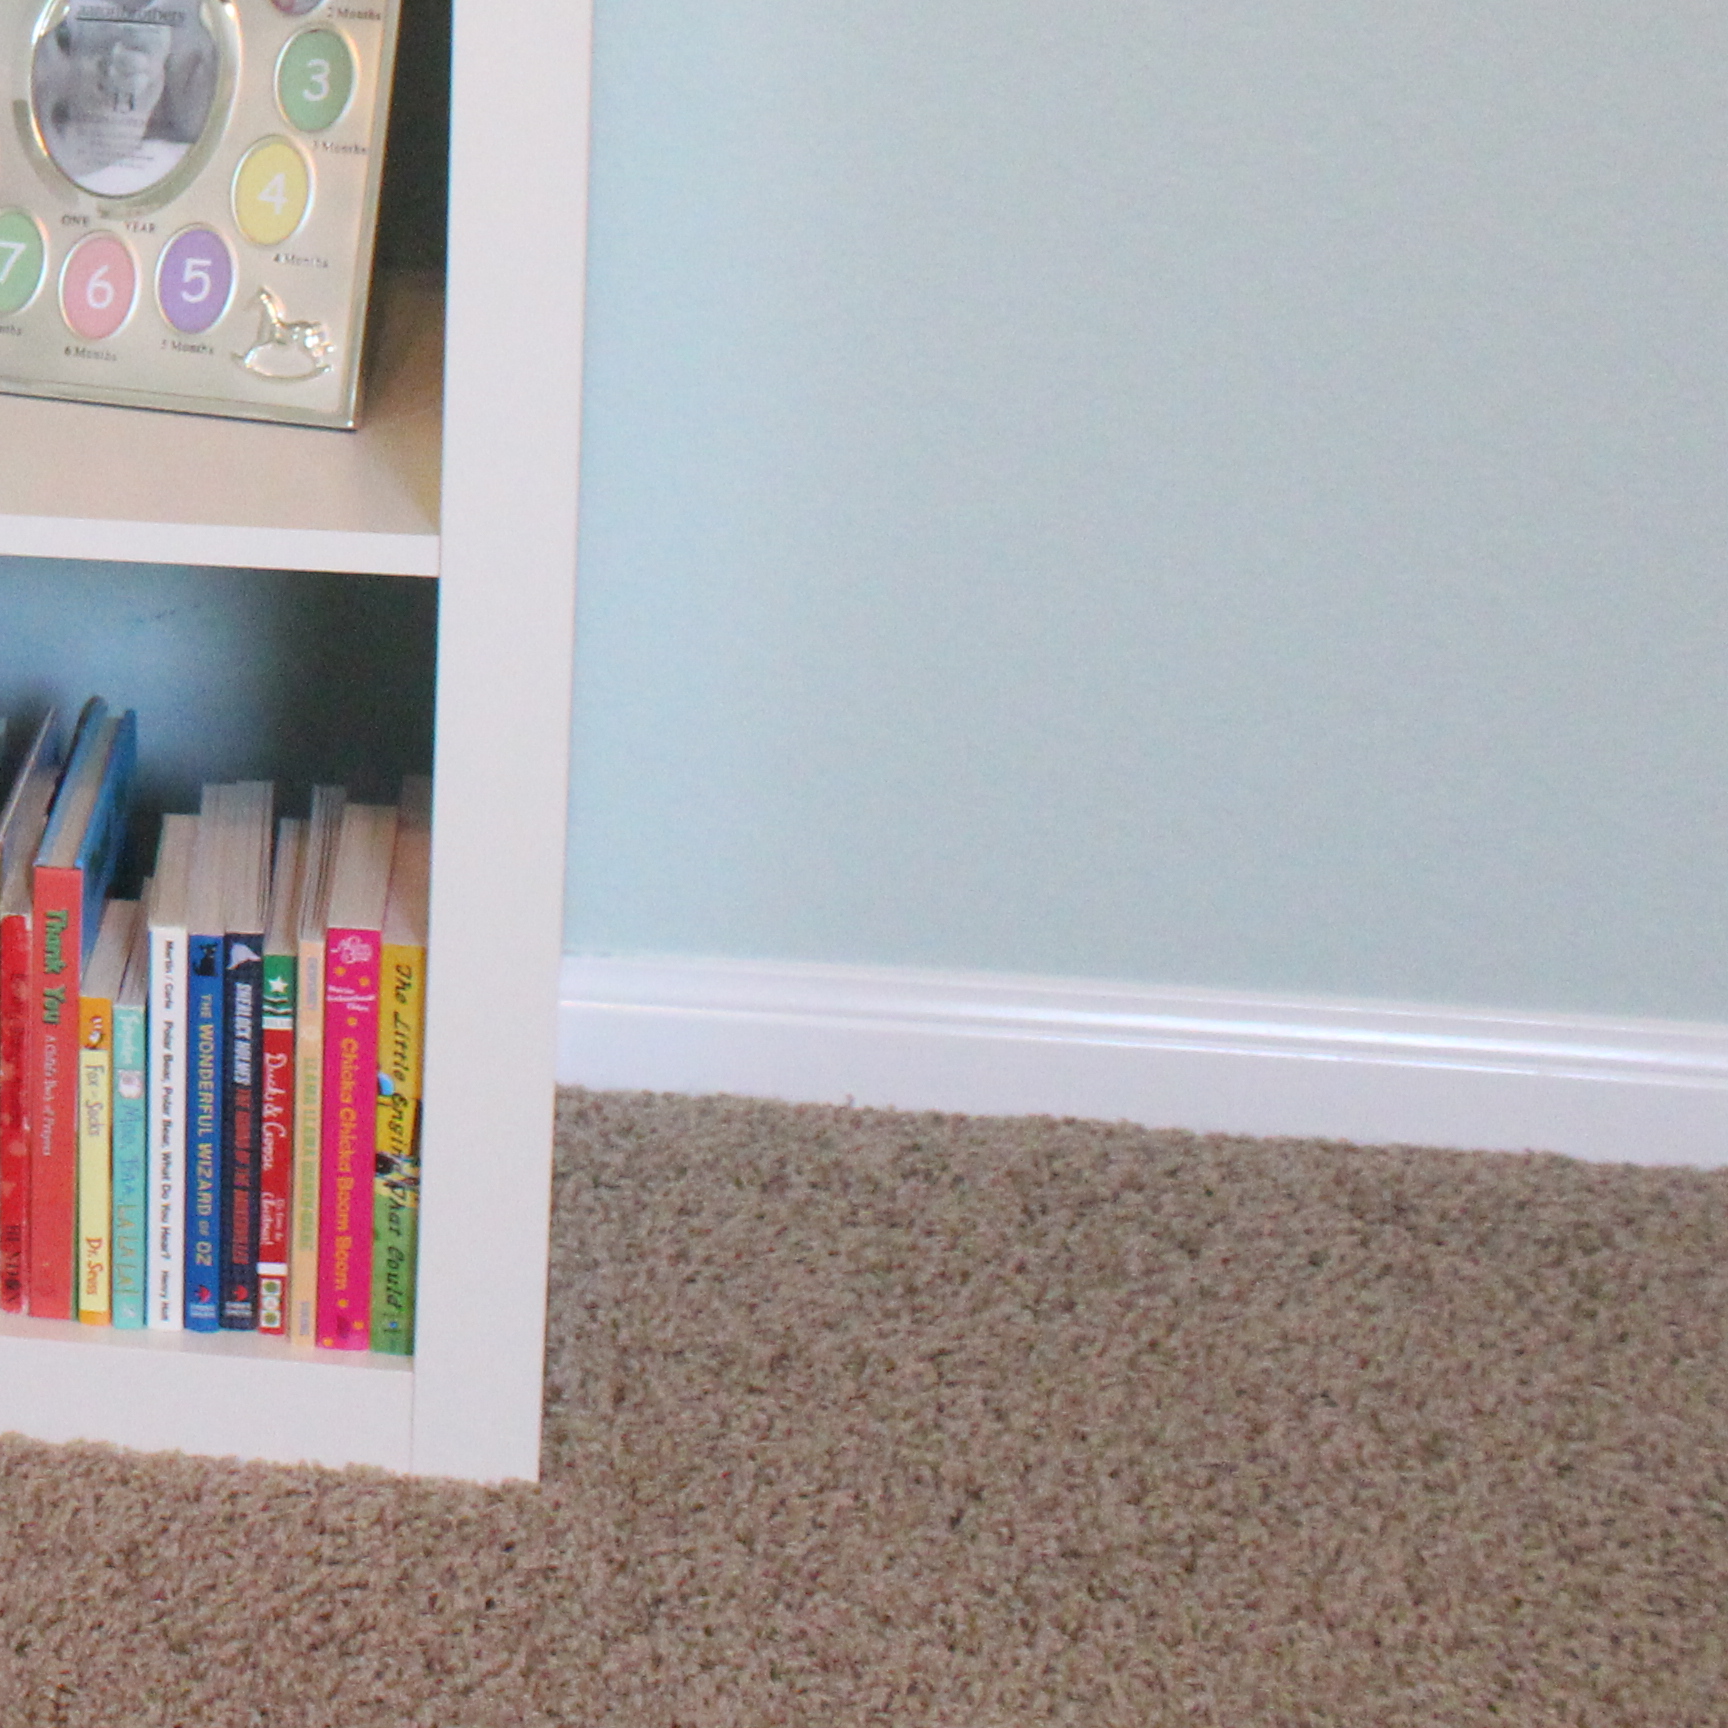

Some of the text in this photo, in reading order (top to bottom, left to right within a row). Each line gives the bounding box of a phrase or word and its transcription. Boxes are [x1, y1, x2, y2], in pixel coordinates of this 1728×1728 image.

[301, 58, 331, 102] 3
[256, 173, 288, 216] 4
[85, 266, 116, 310] 6
[181, 257, 212, 303] 5
[42, 909, 69, 975] Thank
[164, 940, 174, 974] Martin
[163, 983, 174, 1010] Carle
[394, 964, 413, 1004] The
[41, 986, 67, 1025] You
[199, 993, 213, 1018] THE
[163, 1021, 175, 1050] Polar
[233, 982, 252, 1086] SHERLOCK HOLMES
[392, 1011, 413, 1084] Little
[161, 1054, 174, 1084] Bear,
[196, 1023, 216, 1137] WONDERFUL
[262, 1052, 286, 1101] Duck
[85, 1064, 106, 1137] Fox Socks
[161, 1086, 173, 1115] Polar
[262, 1104, 283, 1119] &
[160, 1119, 172, 1148] Bear,
[260, 1121, 286, 1172] Goose
[160, 1151, 172, 1179] What
[195, 1142, 214, 1216] WIZARD
[335, 1037, 359, 1291] Chicka Chicka Boom Boom
[160, 1181, 171, 1200] Do
[160, 1203, 171, 1223] You
[159, 1225, 171, 1260] Hear?
[195, 1241, 213, 1266] OZ
[85, 1237, 104, 1296] Dr. Seuss
[158, 1270, 170, 1298] Henry
[386, 1245, 405, 1312] Could
